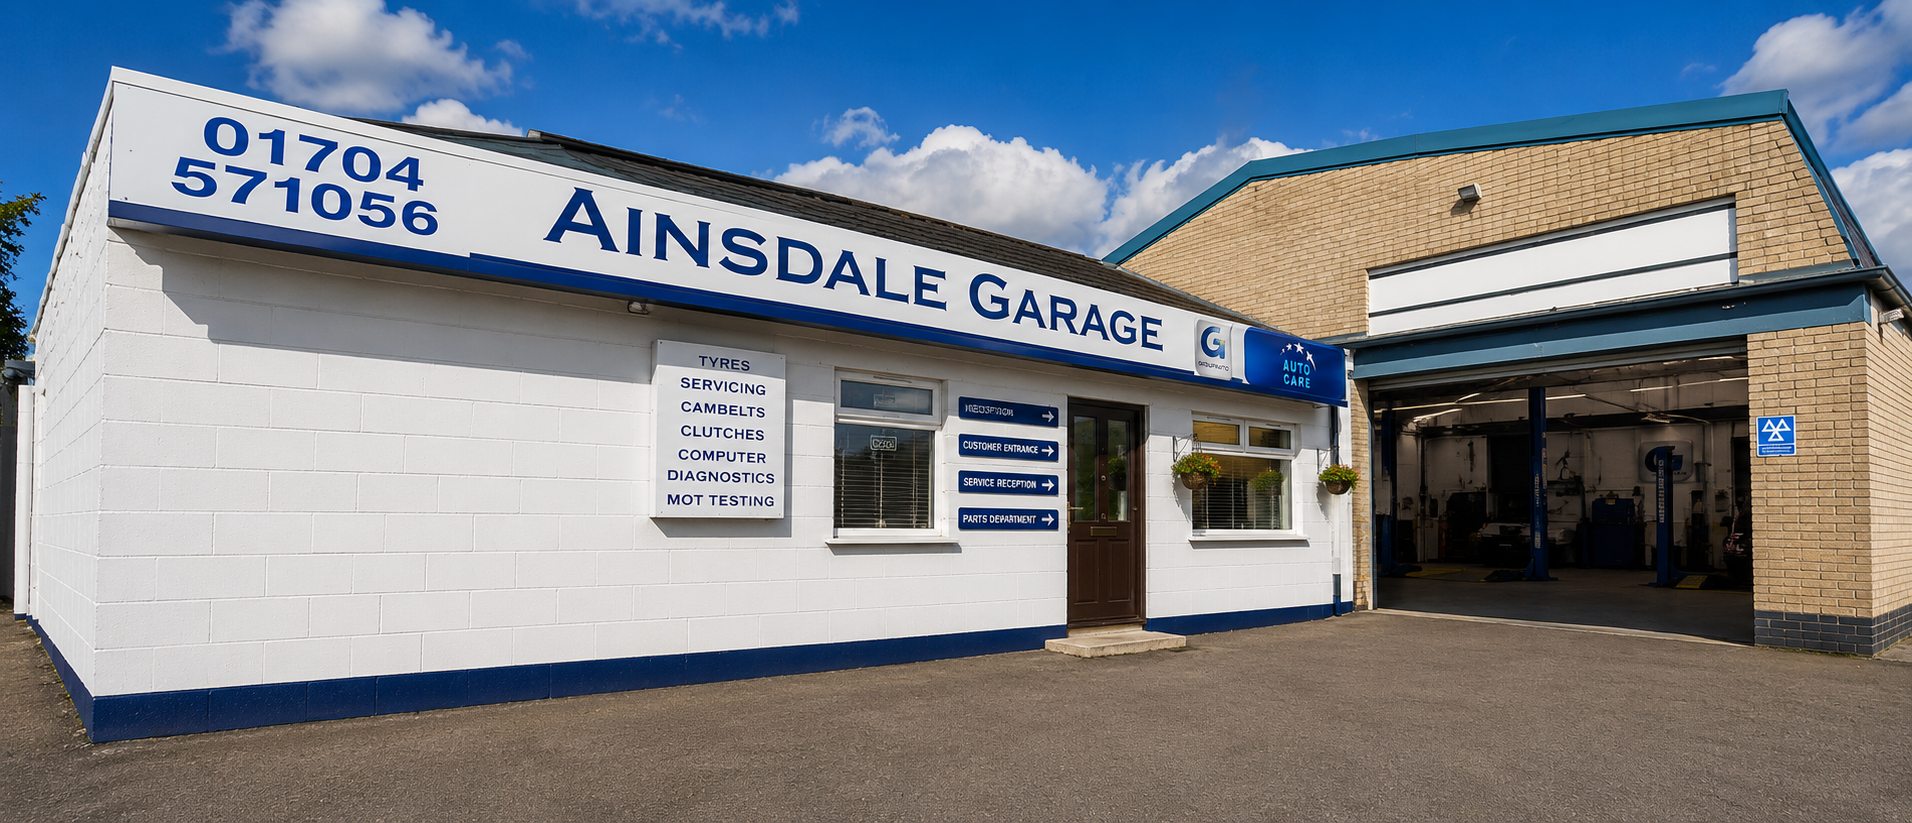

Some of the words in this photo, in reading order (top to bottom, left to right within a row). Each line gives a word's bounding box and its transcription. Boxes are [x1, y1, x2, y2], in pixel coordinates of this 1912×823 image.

[204, 117, 424, 192] 01704
[171, 156, 438, 236] 571056
[543, 187, 947, 311] AINSDALE
[969, 273, 1163, 352] GARAGE
[698, 355, 750, 371] TYRES
[1283, 359, 1310, 376] AUTO
[681, 377, 766, 396] SERVICING
[1283, 373, 1310, 389] CARE
[681, 401, 765, 418] CAMBELTS
[681, 425, 764, 441] CLUTCHES
[678, 449, 766, 464] COMPUTER
[668, 470, 774, 484] DIAGNOSTICS
[963, 477, 994, 487] SERVICE
[997, 479, 1036, 489] RECEPTION
[667, 494, 704, 506] MOT
[709, 495, 774, 507] TESTING
[963, 514, 987, 523] PARTS
